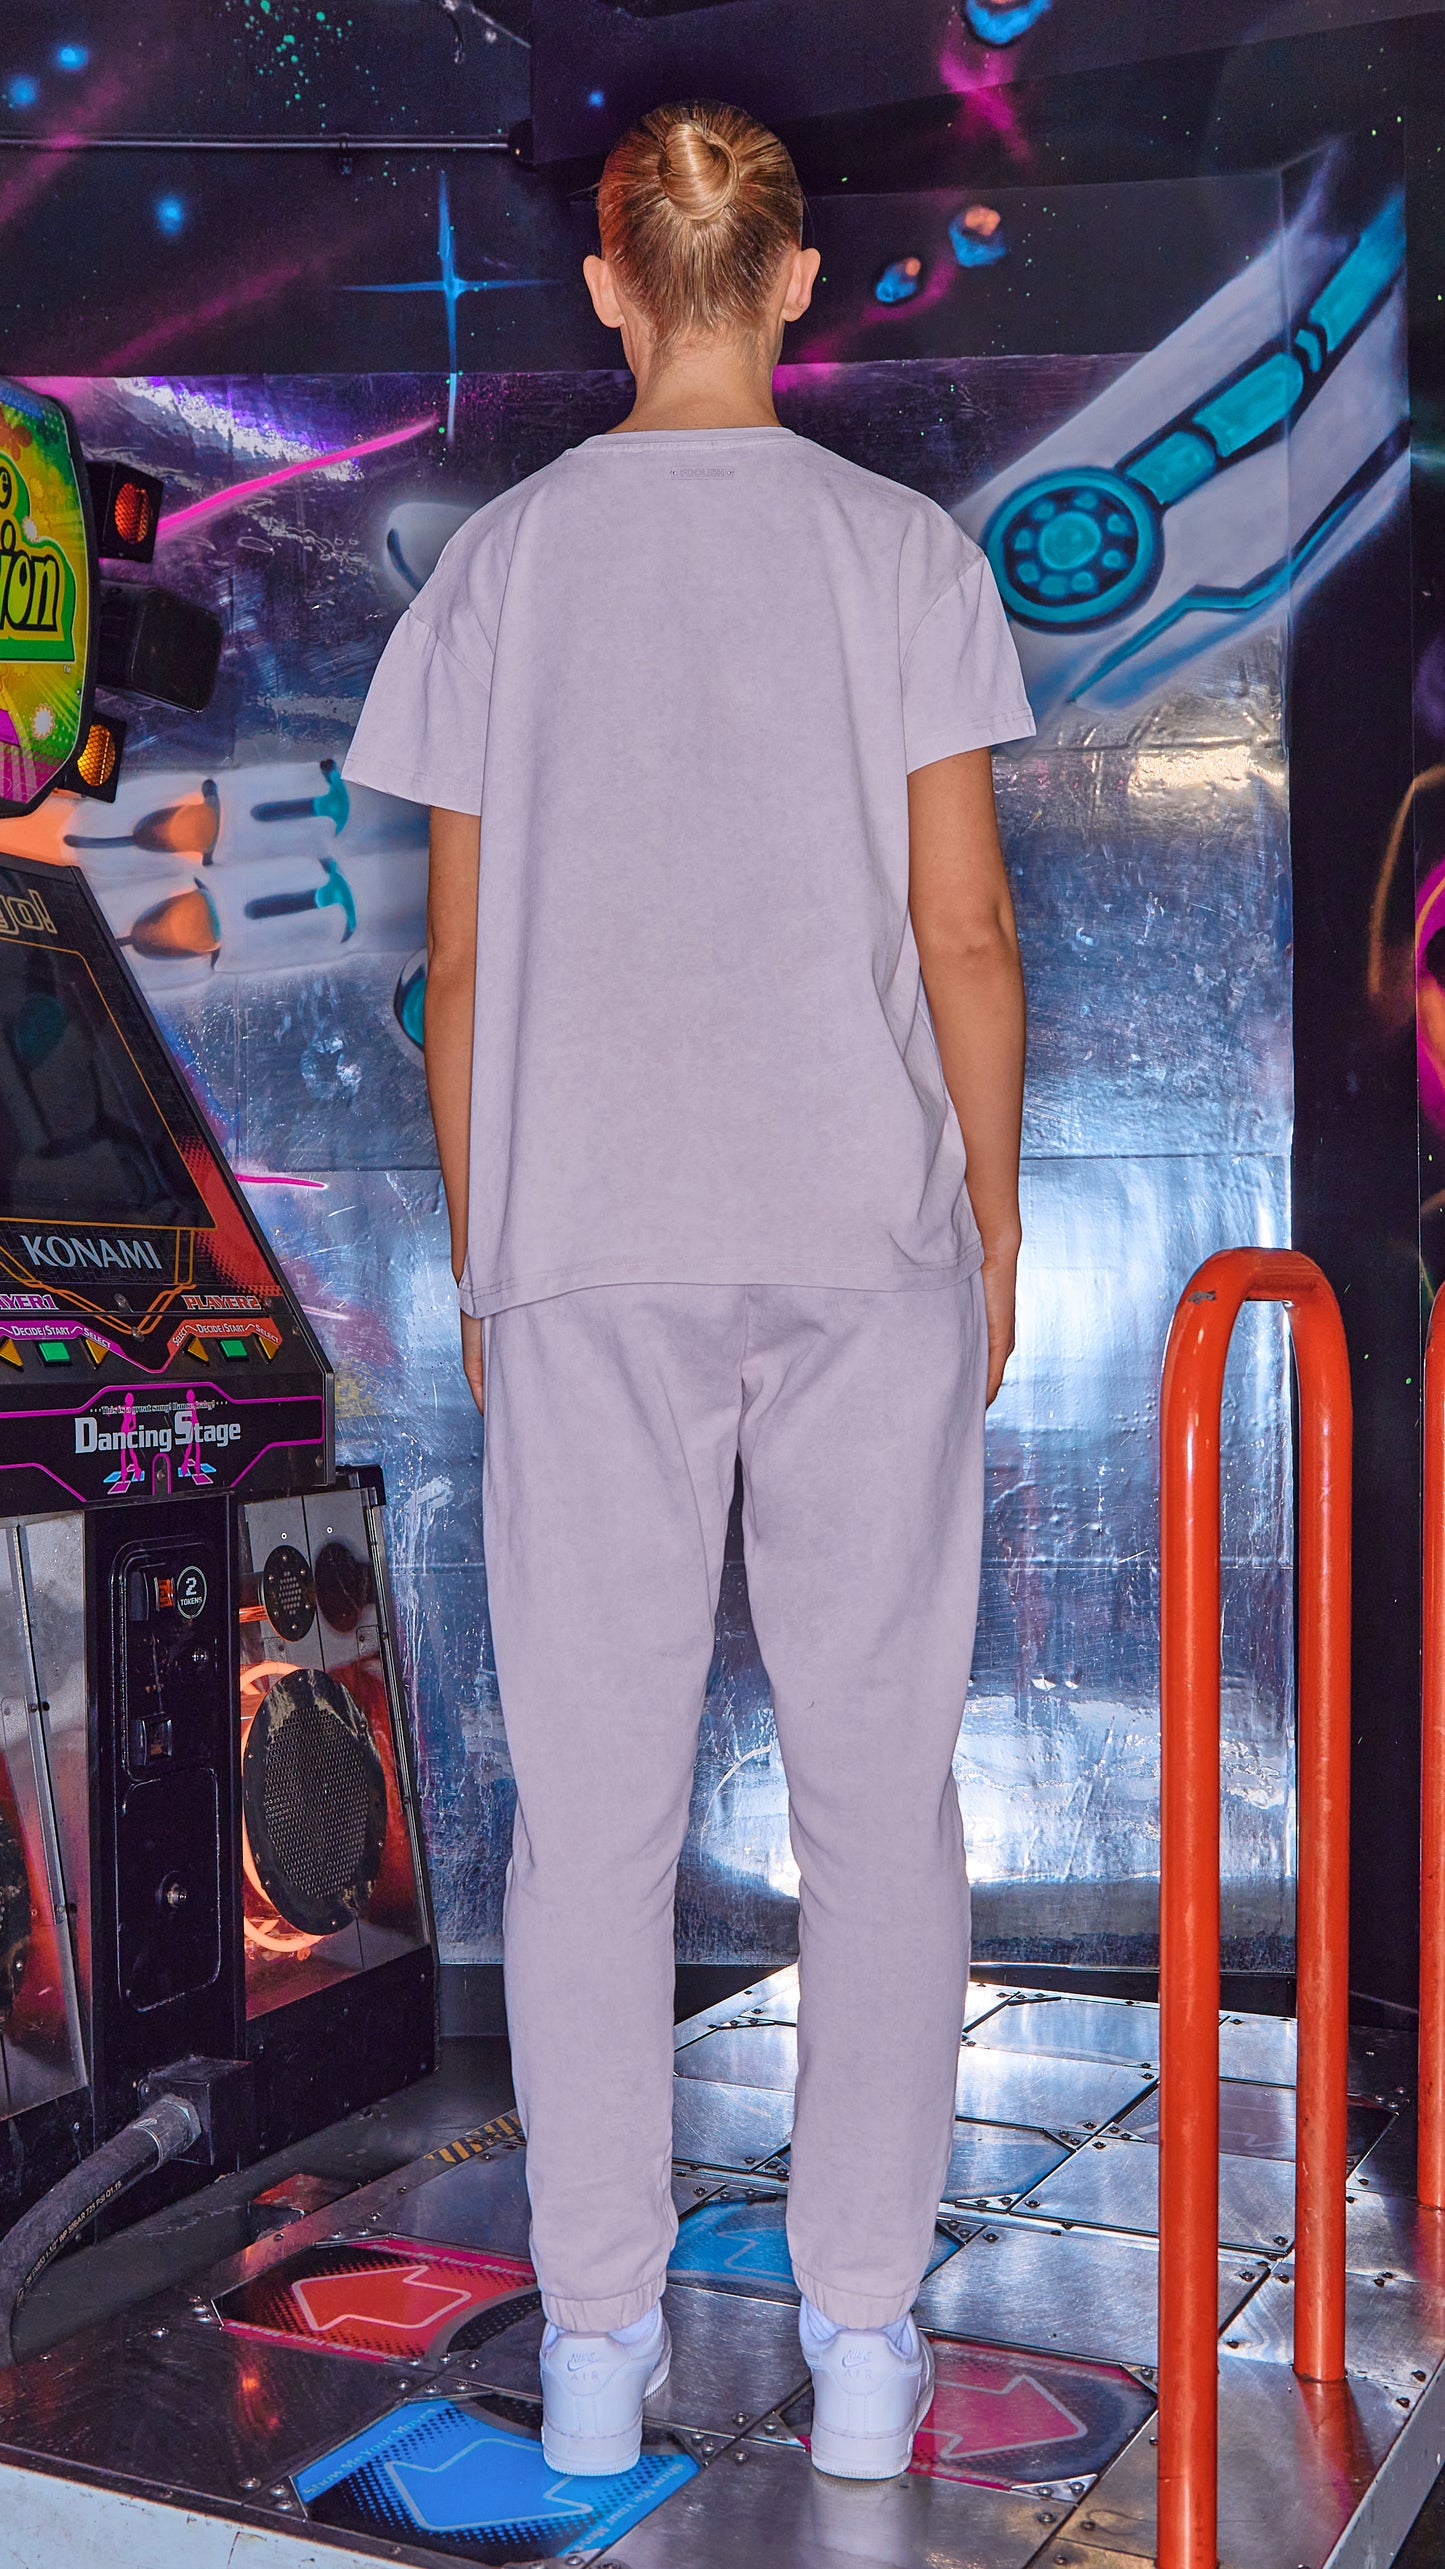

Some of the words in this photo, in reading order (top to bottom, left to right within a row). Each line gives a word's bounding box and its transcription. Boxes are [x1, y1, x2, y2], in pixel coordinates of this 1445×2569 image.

[20, 1235, 162, 1270] KONAMI
[181, 1295, 261, 1310] PLAYER2
[74, 1416, 172, 1453] Dancing
[174, 1411, 241, 1447] Stage
[186, 1577, 197, 1596] 2
[180, 1596, 202, 1606] TOKENS
[360, 2433, 394, 2457] Your
